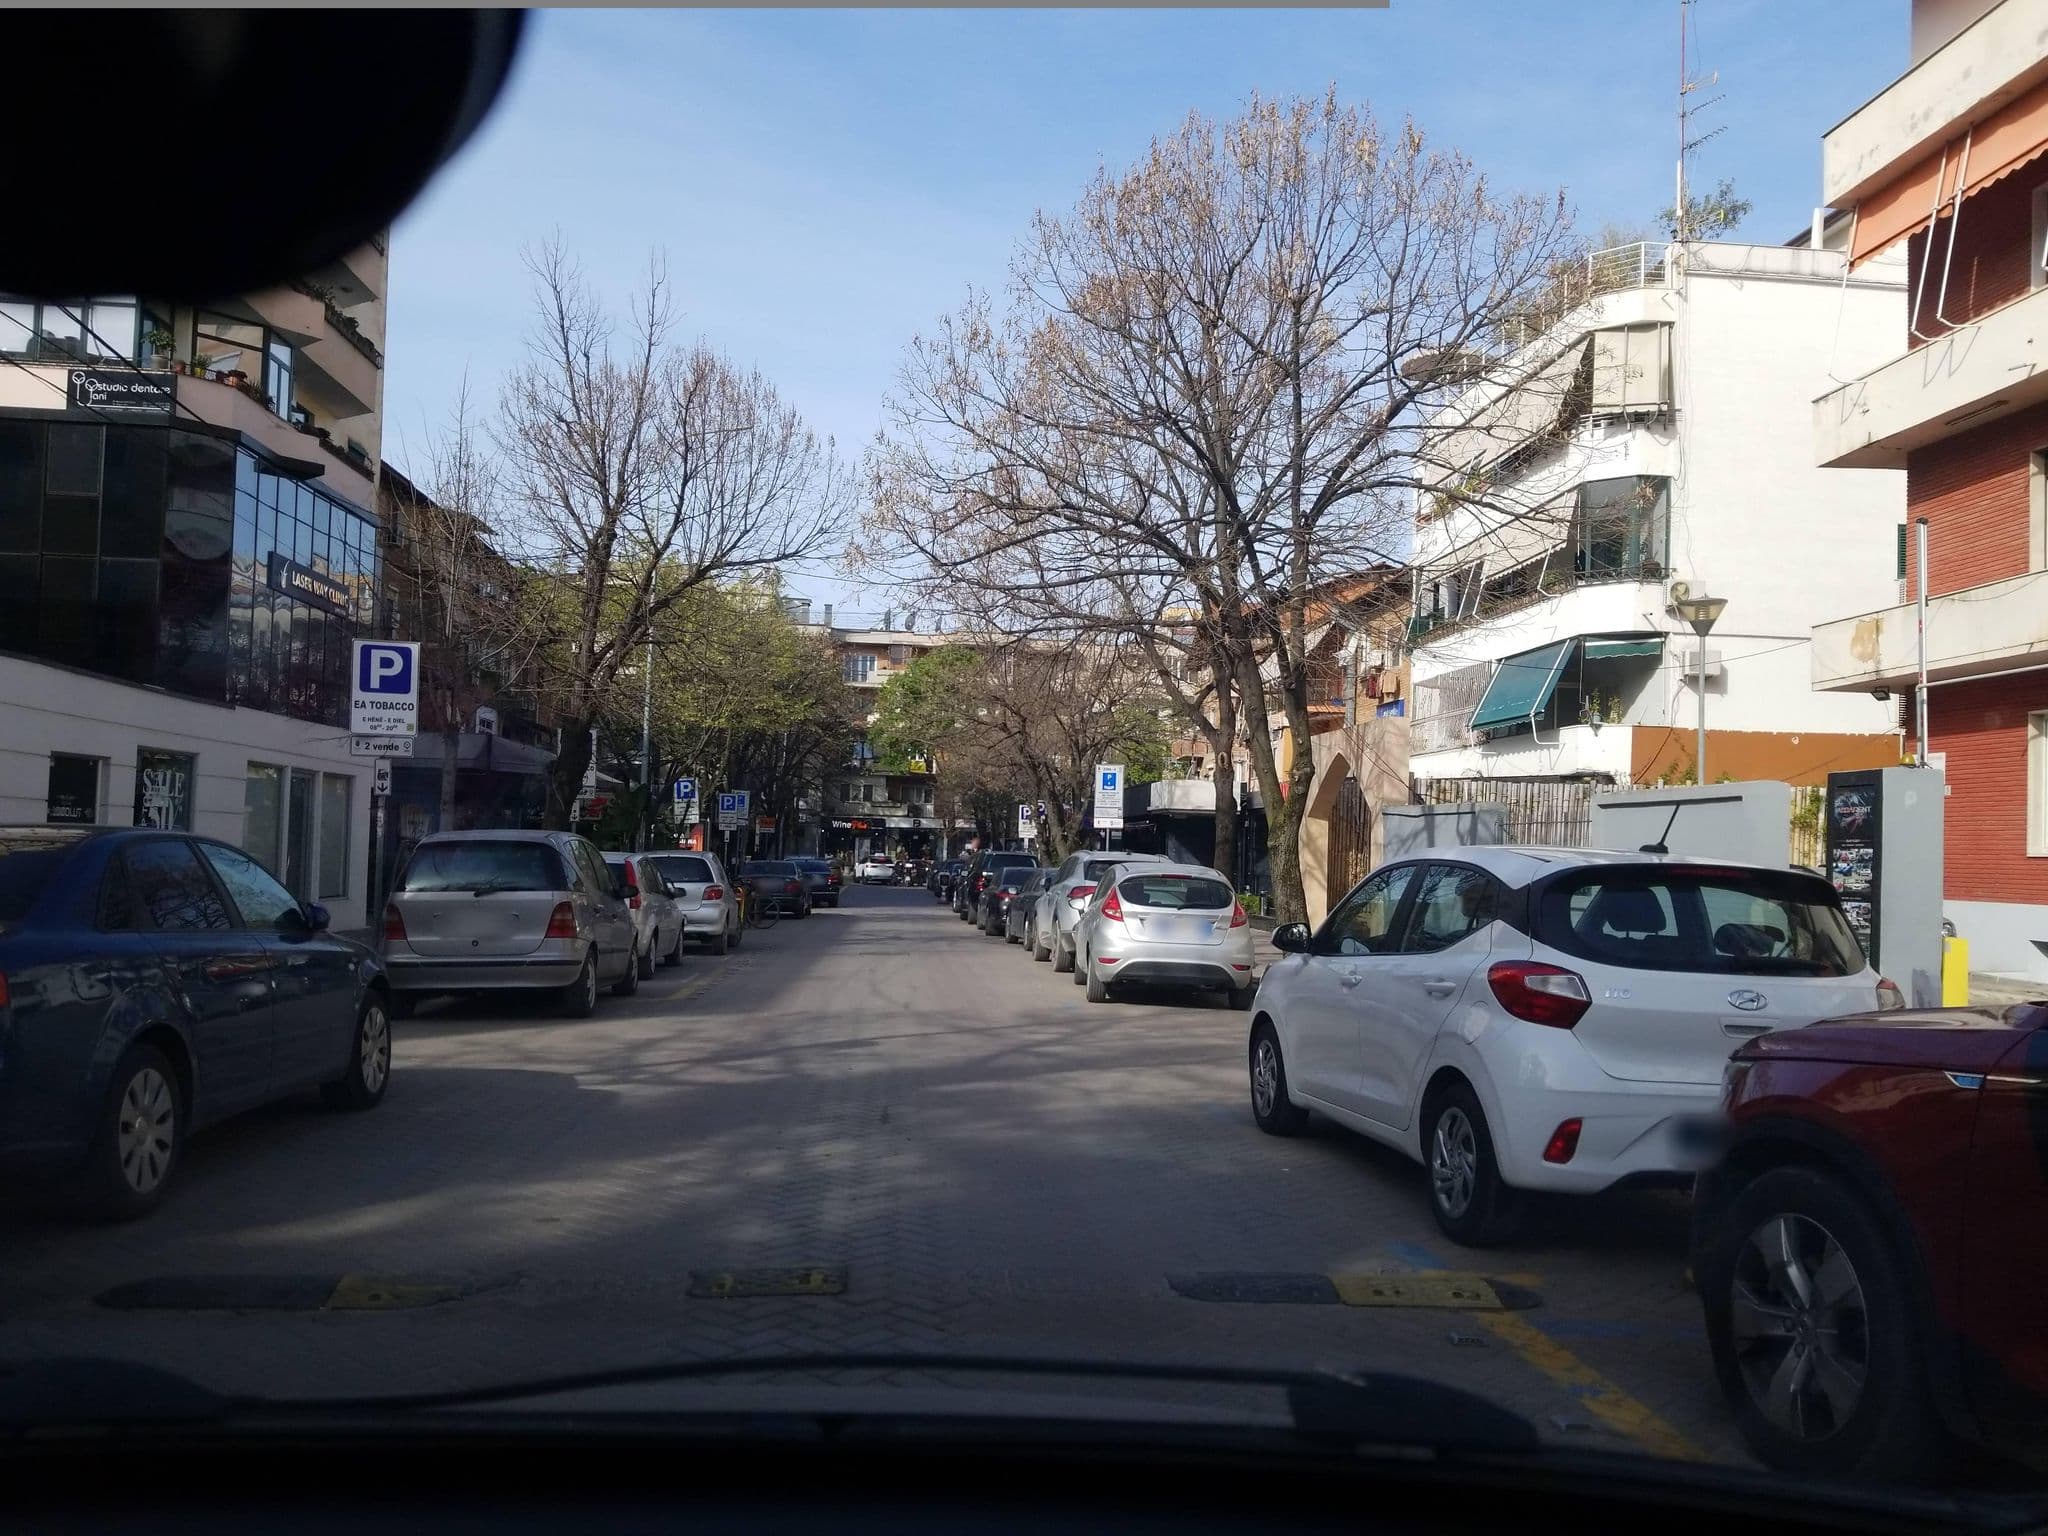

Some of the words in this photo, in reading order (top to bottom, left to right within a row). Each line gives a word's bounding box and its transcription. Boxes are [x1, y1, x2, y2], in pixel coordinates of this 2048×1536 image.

[292, 570, 313, 591] LASER
[313, 579, 328, 598] WAY
[328, 588, 349, 609] CLINIC
[370, 649, 404, 689] P
[354, 700, 367, 709] EA
[369, 701, 415, 711] TOBACCO
[364, 742, 370, 750] 2
[373, 743, 400, 751] vende
[680, 781, 691, 796] P
[723, 796, 733, 809] P
[1023, 807, 1031, 819] P
[831, 820, 852, 829] Wine
